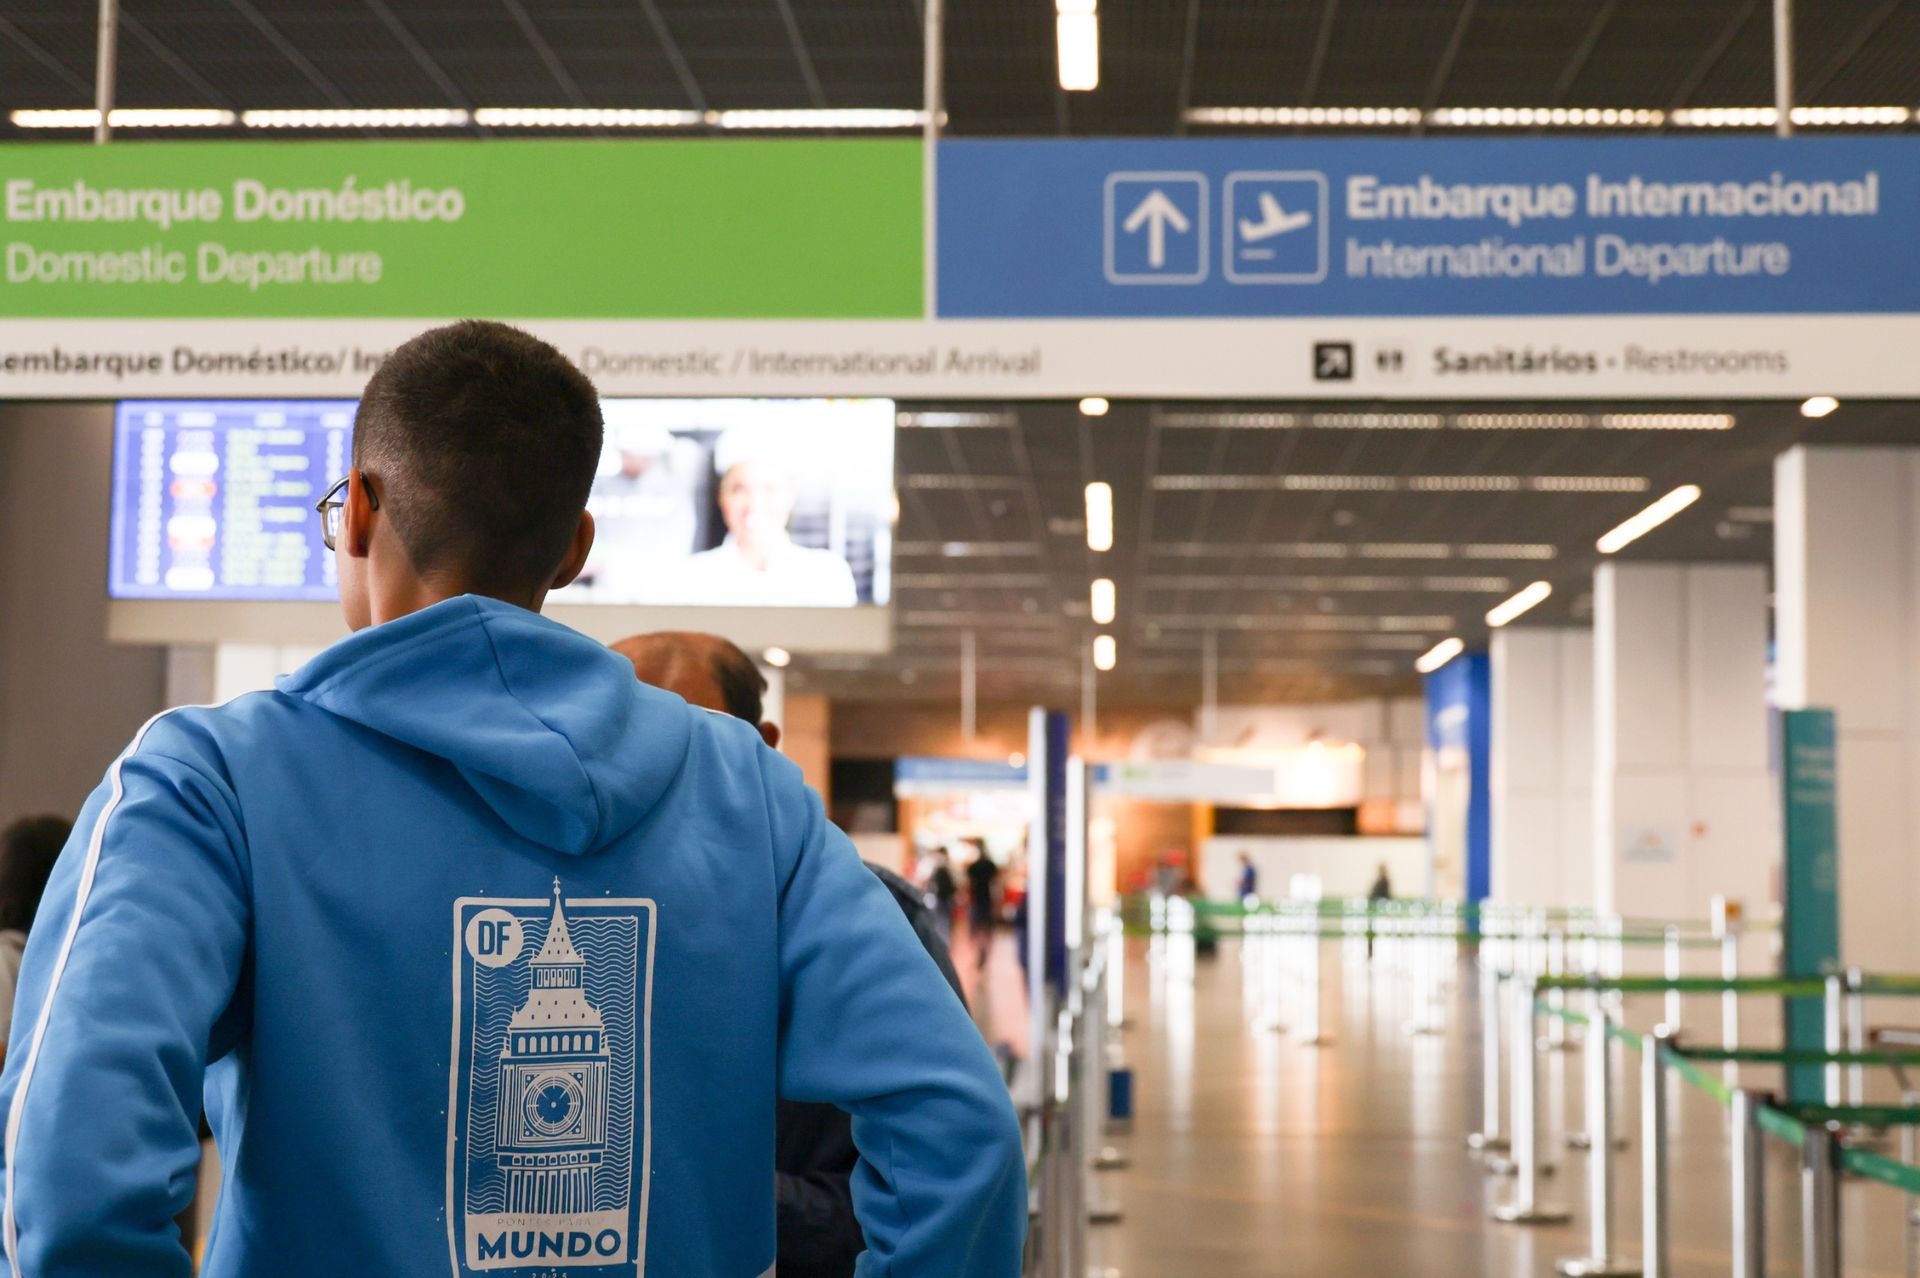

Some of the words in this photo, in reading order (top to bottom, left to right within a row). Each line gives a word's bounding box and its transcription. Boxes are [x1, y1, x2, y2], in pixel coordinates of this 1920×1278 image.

[6, 179, 223, 229] Embarque
[234, 176, 465, 222] Doméstico
[1347, 175, 1576, 226] Embarque
[1587, 172, 1878, 217] Internacional
[6, 243, 186, 283] Domestic
[197, 243, 383, 291] Departure
[1346, 236, 1585, 279] International
[1594, 234, 1790, 283] Departure
[581, 347, 720, 376] Domestic
[749, 347, 937, 375] International
[944, 348, 1041, 375] Arrival
[1433, 345, 1598, 375] Sanitários
[1624, 345, 1790, 374] Restrooms
[478, 920, 512, 956] DF
[477, 1228, 621, 1260] MUNDO
